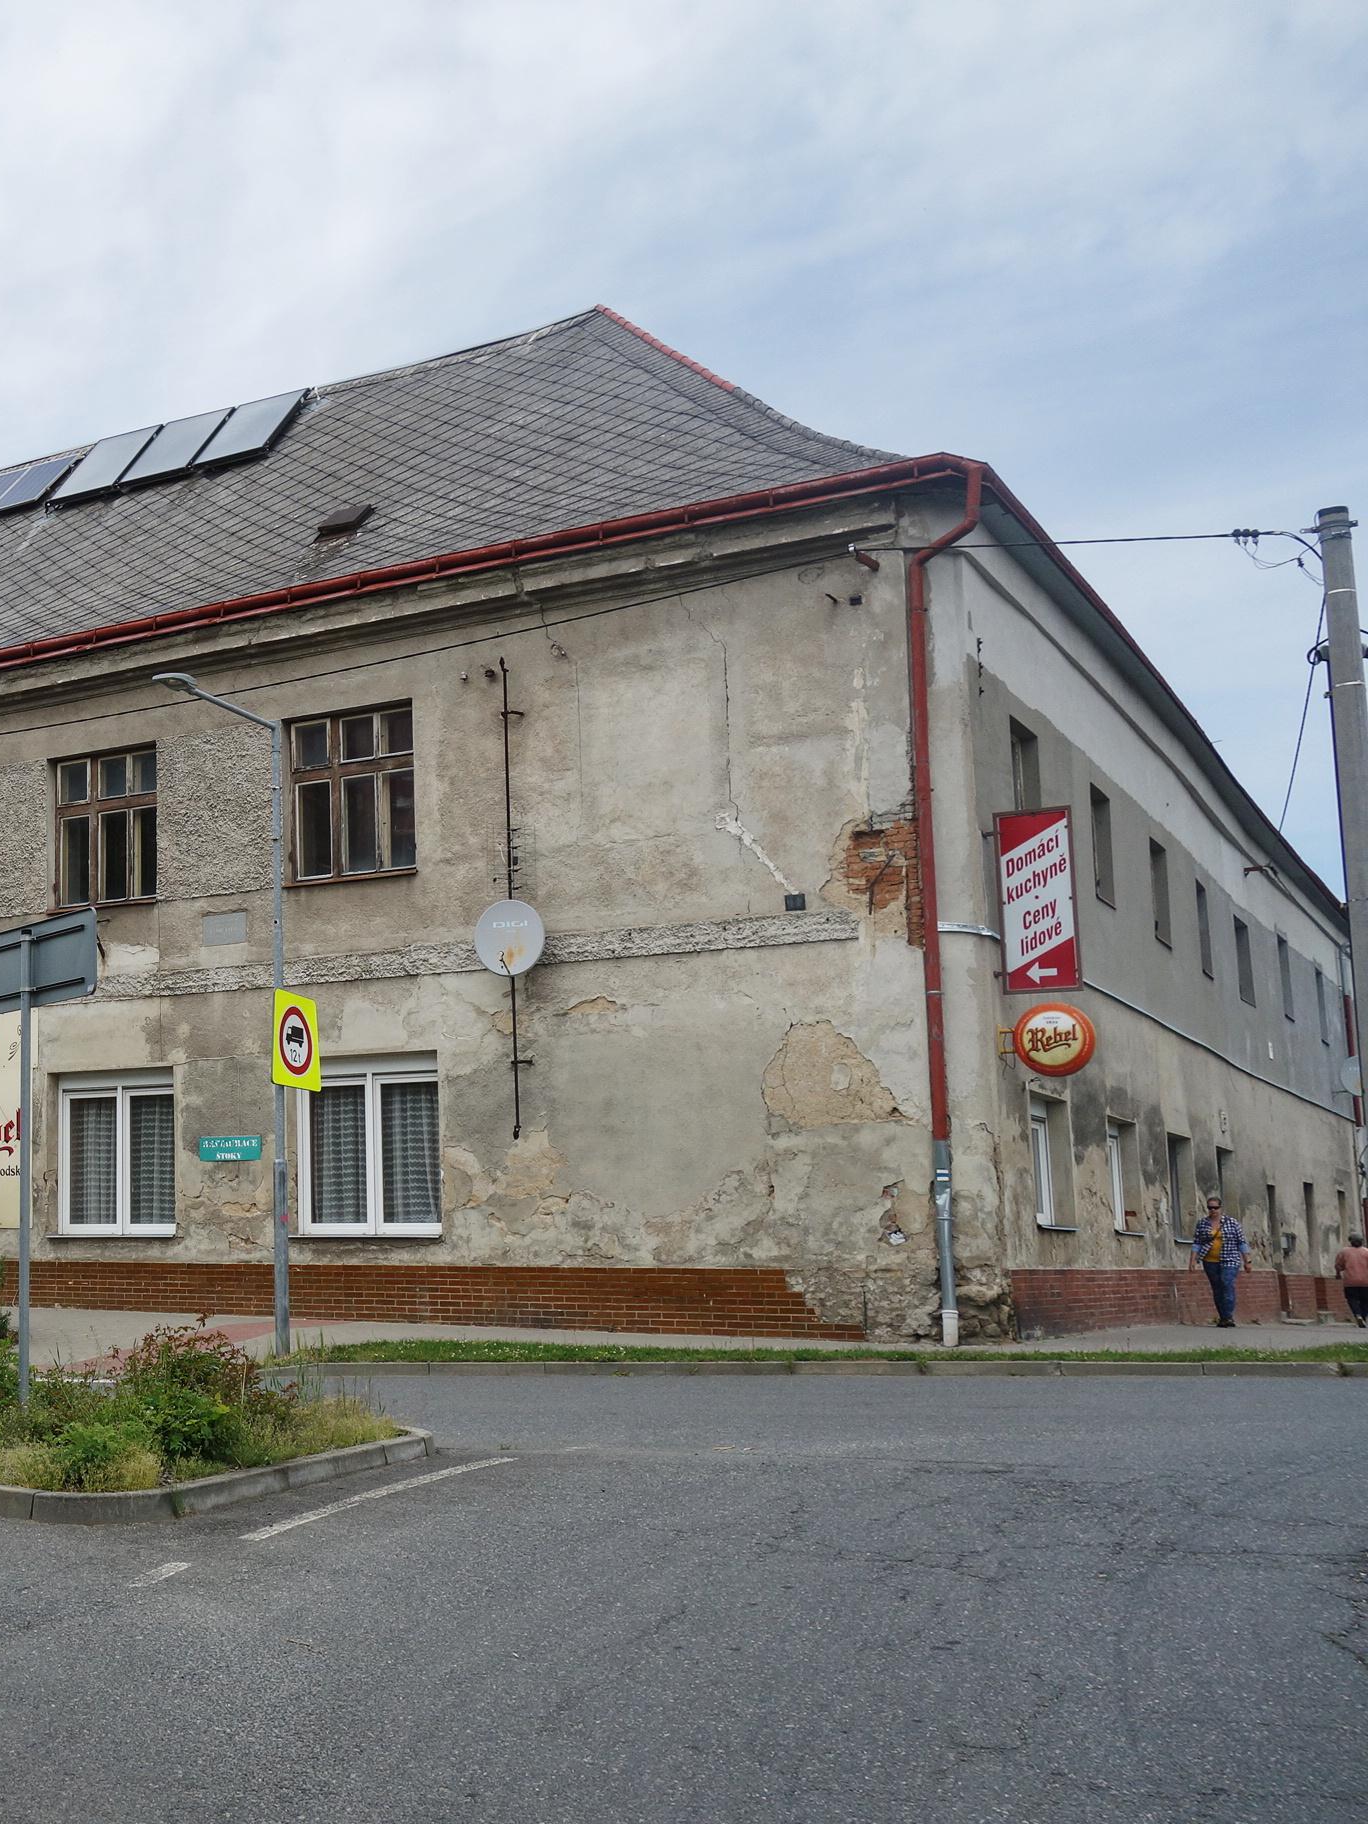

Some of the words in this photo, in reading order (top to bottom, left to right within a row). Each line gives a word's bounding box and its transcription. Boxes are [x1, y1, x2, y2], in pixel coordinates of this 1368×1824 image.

[1006, 829, 1059, 878] Domácí
[1007, 853, 1067, 904] kuchyně
[492, 920, 528, 928] DIGI
[1022, 899, 1057, 930] Ceny
[1020, 917, 1062, 956] lidové
[1026, 1023, 1079, 1062] Rebel
